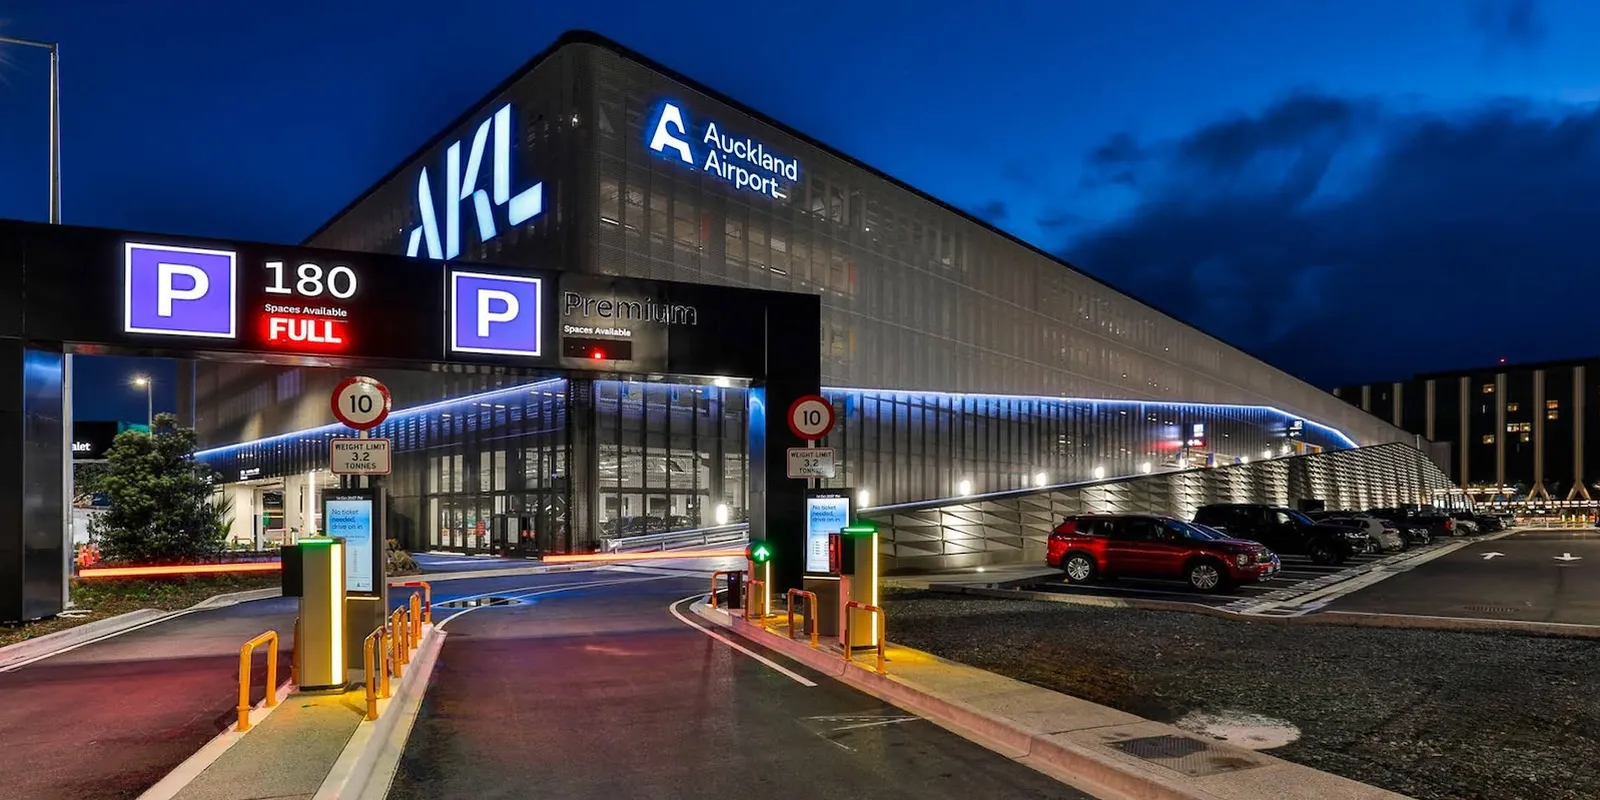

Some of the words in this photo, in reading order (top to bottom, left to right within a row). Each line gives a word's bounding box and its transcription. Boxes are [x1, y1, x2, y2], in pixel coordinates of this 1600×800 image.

[703, 122, 798, 182] Auckland
[406, 103, 543, 261] AKL
[703, 150, 787, 199] Airport
[157, 263, 210, 317] P
[264, 261, 358, 299] 180
[264, 303, 301, 315] Spaces
[302, 305, 348, 317] Available
[477, 288, 520, 337] P
[563, 291, 698, 326] Premium
[269, 317, 342, 343] FULL
[563, 324, 594, 335] Spaces
[594, 326, 632, 337] Available
[350, 394, 373, 413] 10
[803, 410, 821, 426] 10
[345, 462, 377, 470] TONNES
[352, 452, 370, 461] 3.2
[804, 459, 819, 467] 3.2
